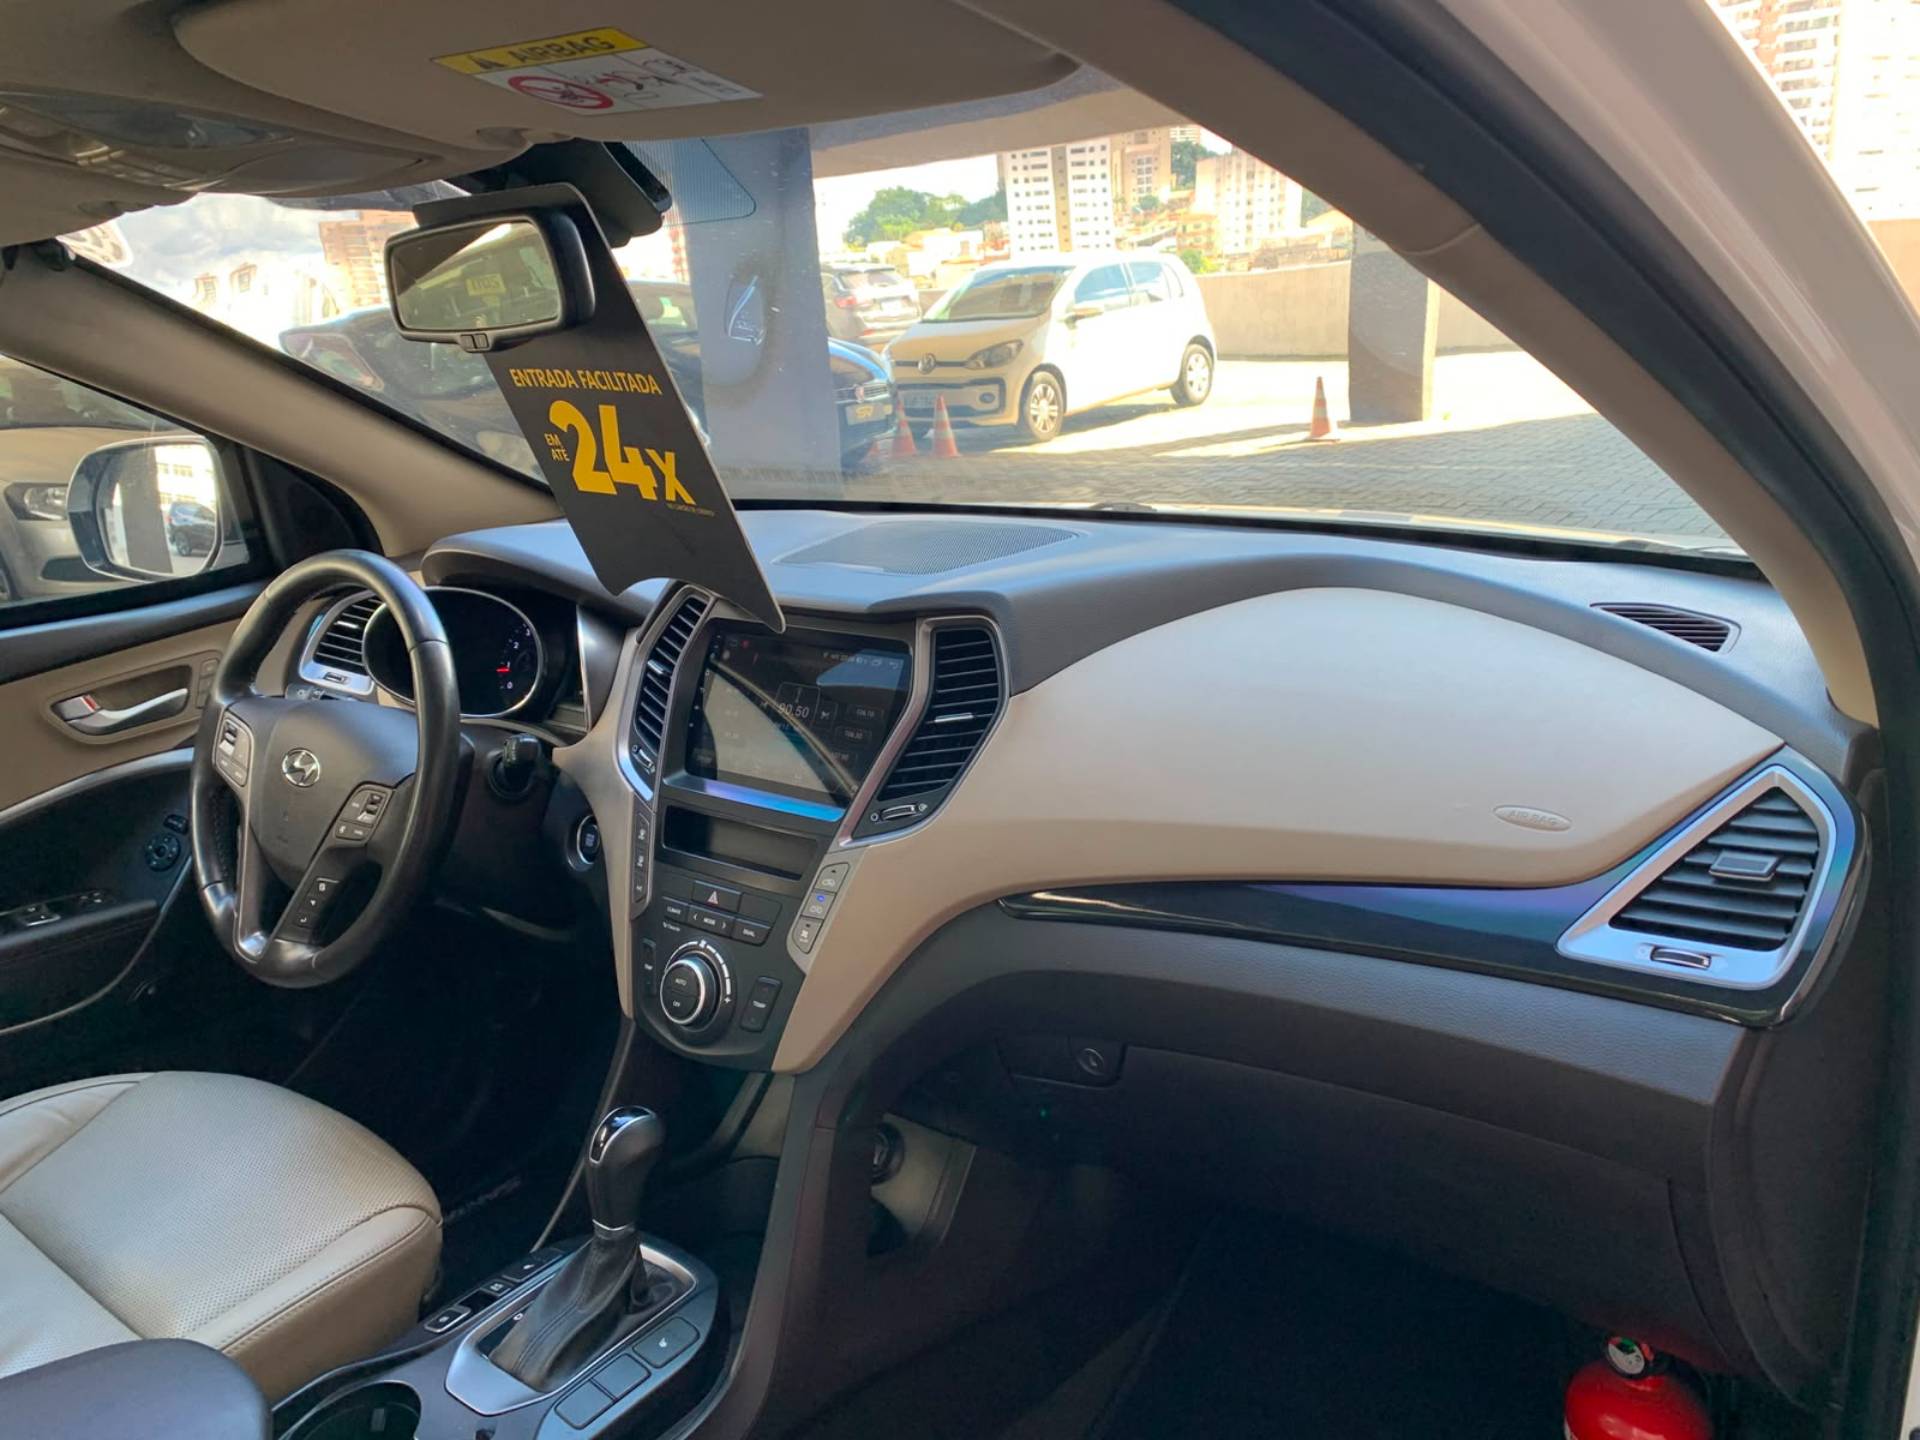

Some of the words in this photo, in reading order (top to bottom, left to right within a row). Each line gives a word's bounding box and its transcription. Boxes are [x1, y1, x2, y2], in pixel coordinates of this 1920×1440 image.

[508, 36, 615, 63] AIRBAG
[509, 368, 579, 389] ENTRADA
[576, 369, 663, 396] FACILITADA
[544, 432, 564, 448] EM
